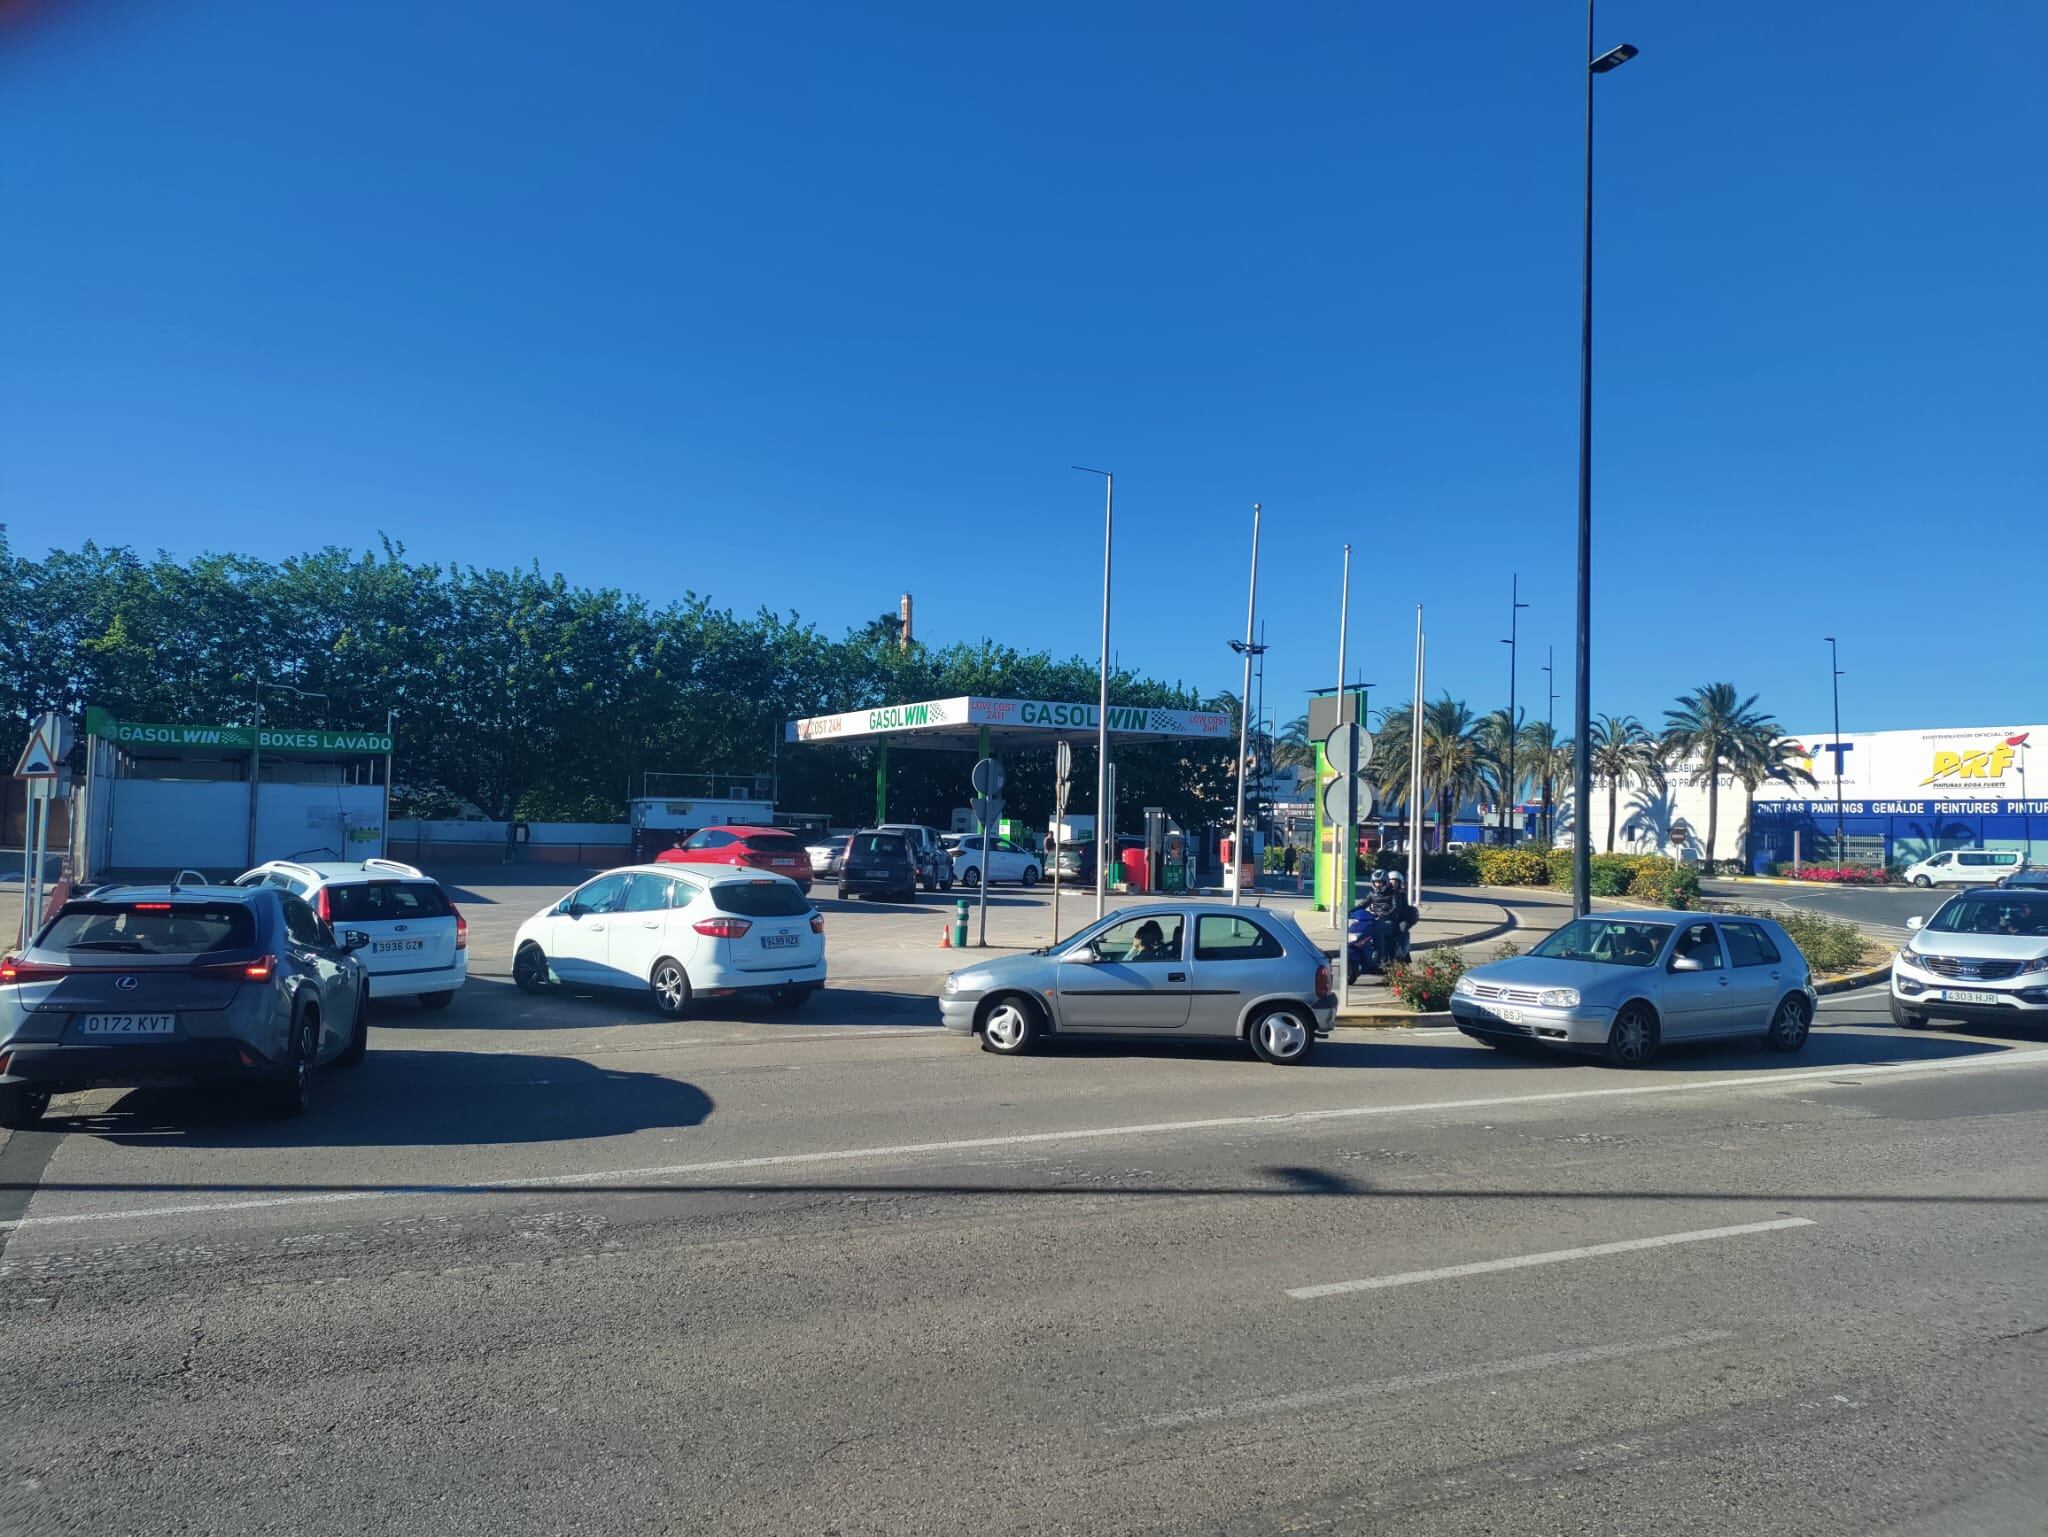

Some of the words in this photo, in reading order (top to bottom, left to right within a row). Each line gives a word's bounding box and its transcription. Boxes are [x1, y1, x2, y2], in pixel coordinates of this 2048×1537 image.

[971, 702, 992, 711] LOW
[994, 703, 1016, 713] COST
[986, 711, 1005, 721] 24H
[1189, 714, 1207, 724] LOW
[1208, 715, 1229, 725] COST
[1202, 723, 1218, 733] 24H
[259, 732, 318, 748] BOXES
[323, 735, 392, 751] LAVADO
[1757, 803, 1805, 814] PINTURAS
[1811, 803, 1864, 814] PAINTNGS
[1872, 800, 1925, 814] GEMÄLDE
[1934, 802, 1998, 814] PEINTURES
[1948, 991, 1973, 1001] 4303
[89, 1017, 132, 1031] 0172
[138, 1016, 170, 1030] KVT
